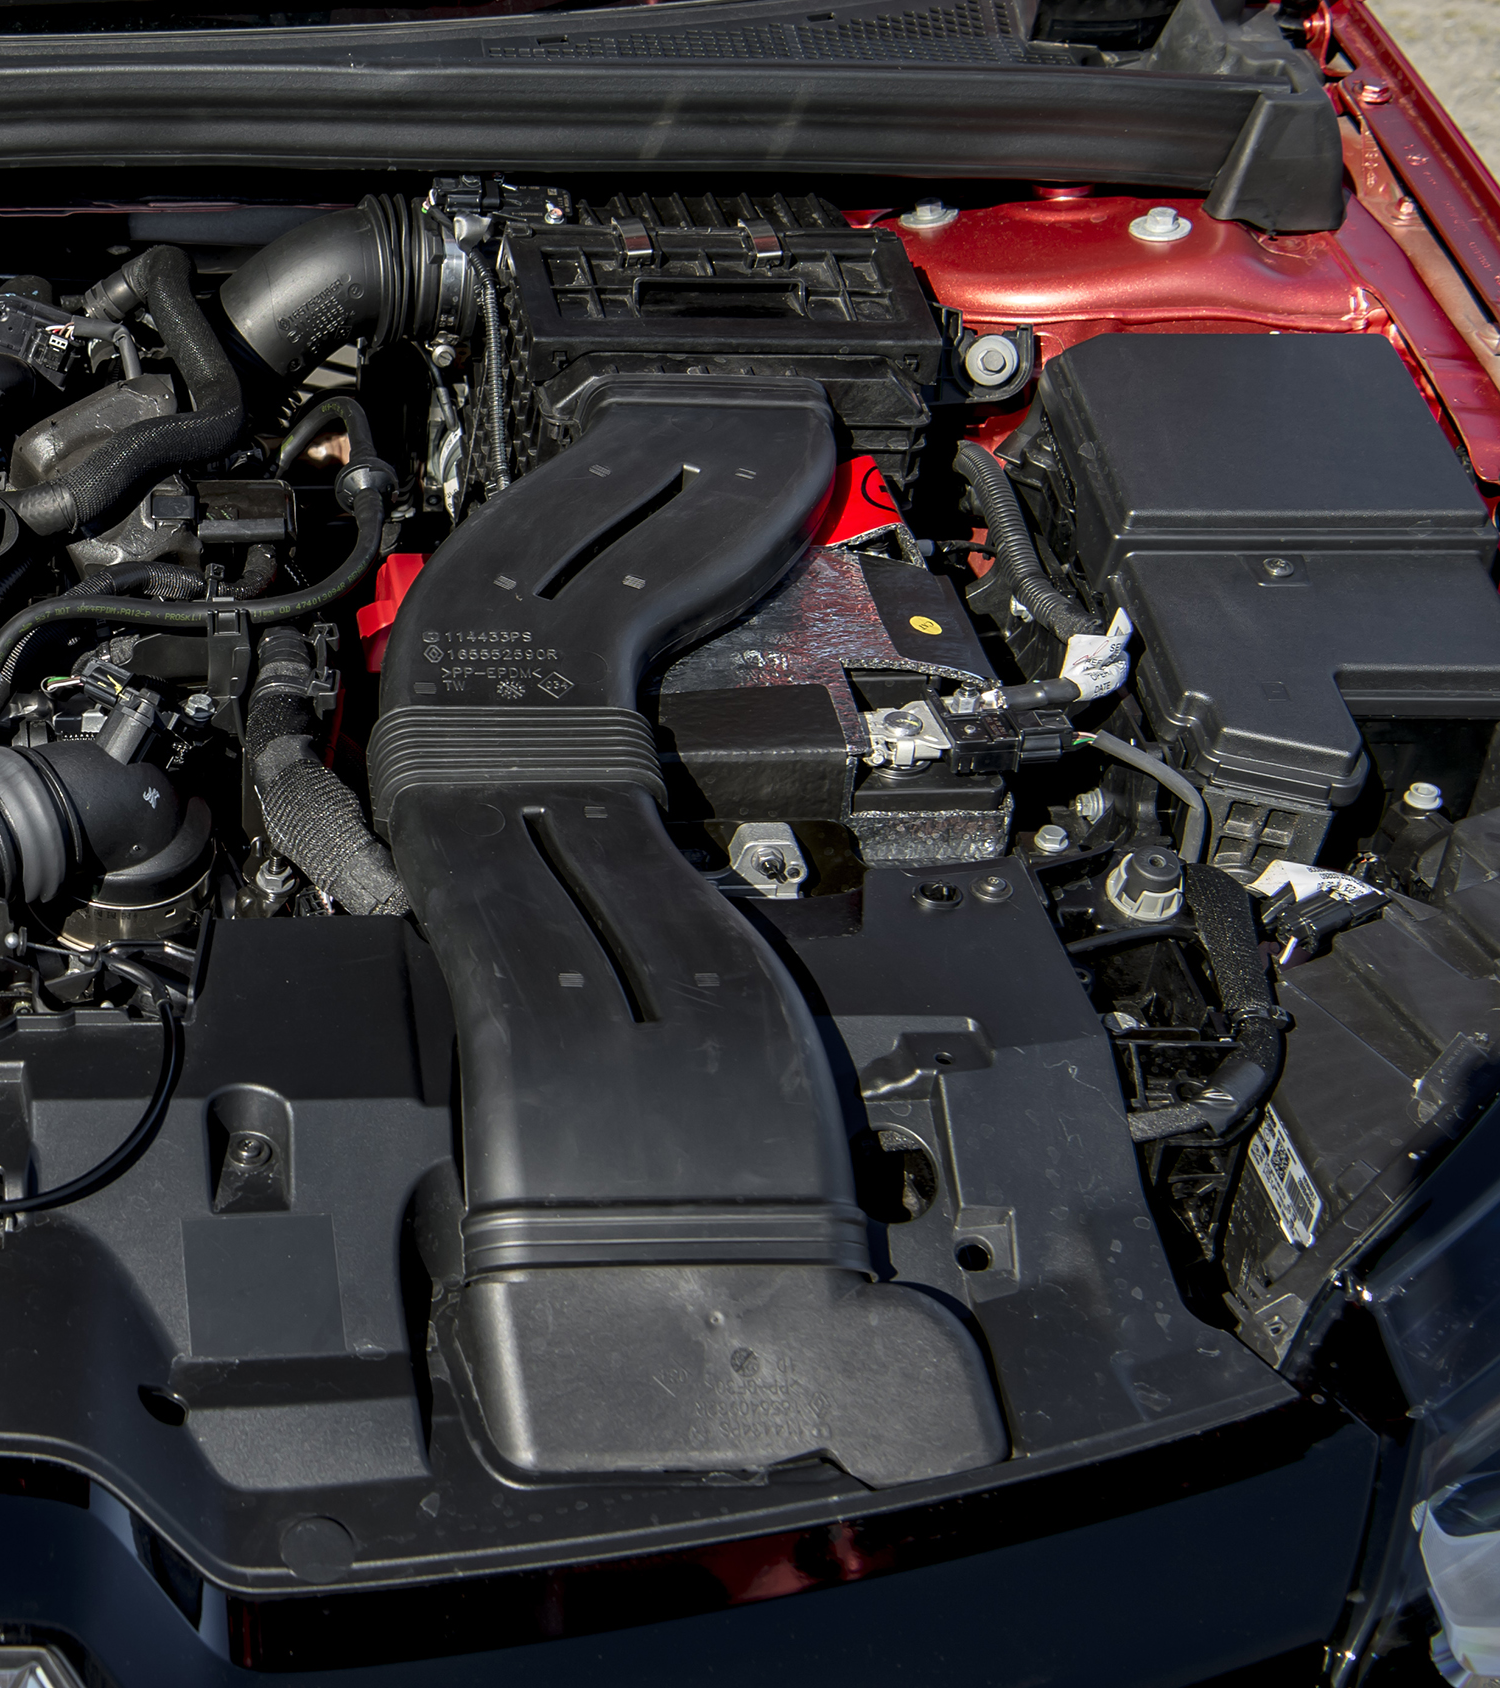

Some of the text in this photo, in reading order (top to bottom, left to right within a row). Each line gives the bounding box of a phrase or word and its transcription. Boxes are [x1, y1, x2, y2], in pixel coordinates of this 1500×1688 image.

[444, 631, 533, 643] 114433PS
[447, 649, 558, 661] 165552590R
[443, 680, 466, 692] TW
